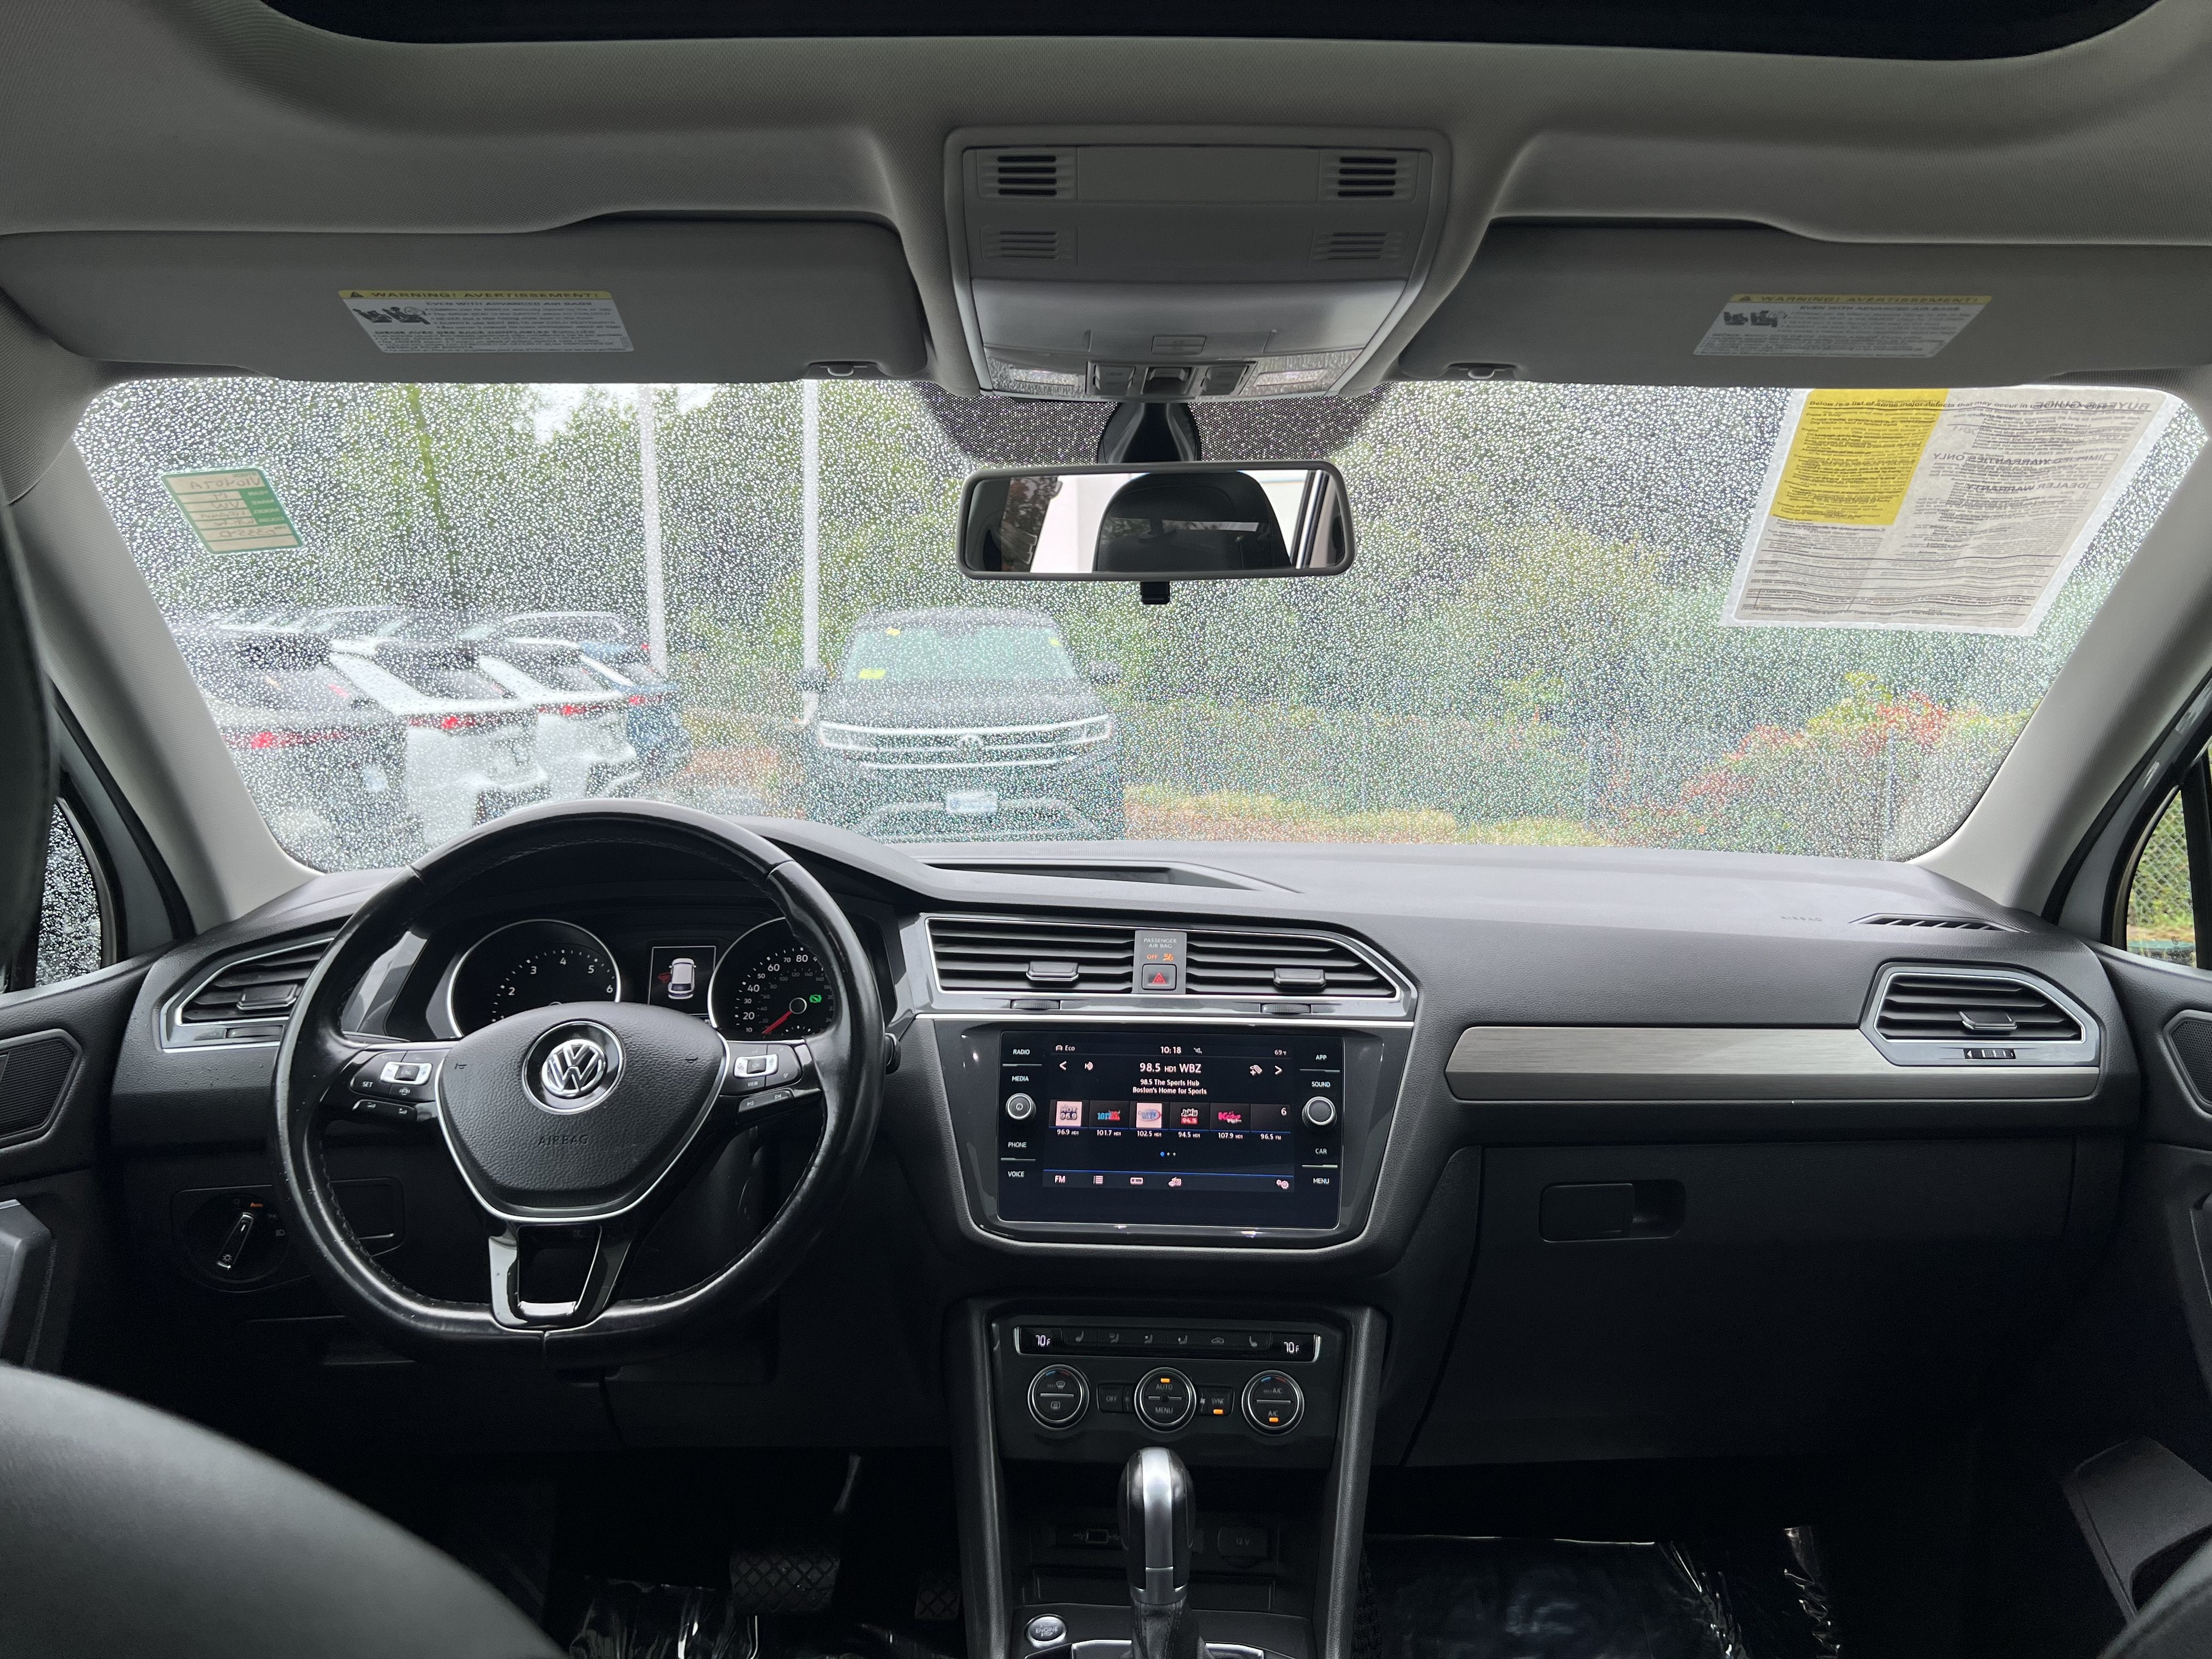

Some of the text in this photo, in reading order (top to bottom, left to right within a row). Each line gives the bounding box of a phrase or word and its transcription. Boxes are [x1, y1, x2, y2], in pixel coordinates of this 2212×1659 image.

[559, 957, 567, 966] 4
[795, 954, 808, 962] 80
[529, 966, 537, 975] 3
[588, 964, 595, 974] 5
[768, 963, 780, 972] 60
[507, 986, 516, 996] 2
[606, 984, 613, 994] 6
[747, 984, 760, 992] 40
[742, 1012, 755, 1020] 20
[1139, 1063, 1161, 1073] 98.5
[1179, 1064, 1201, 1074] WBZ
[1281, 1107, 1287, 1116] 6
[538, 1135, 590, 1146] AIRBAG
[1054, 1175, 1065, 1183] FM
